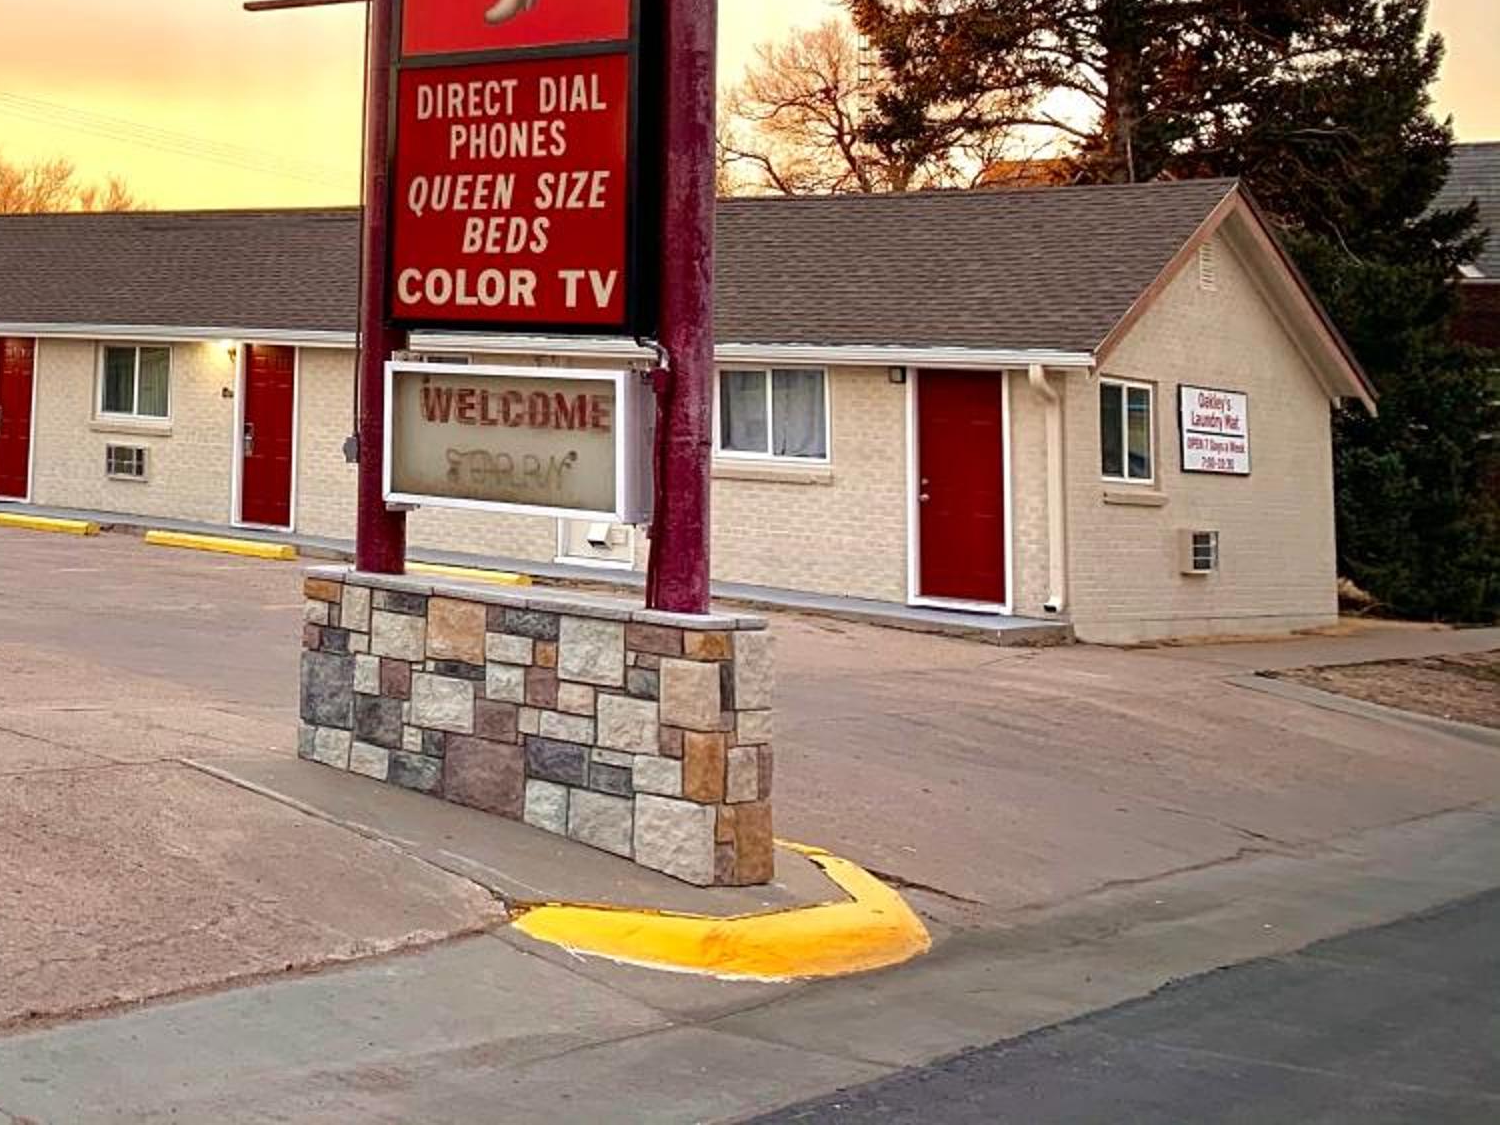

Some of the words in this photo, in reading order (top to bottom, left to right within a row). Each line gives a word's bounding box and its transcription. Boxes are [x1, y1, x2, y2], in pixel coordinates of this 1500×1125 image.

[417, 79, 518, 120] DIRECT
[539, 73, 606, 114] DIAL
[450, 120, 566, 160] PHONES
[407, 174, 515, 217] QUEEN
[534, 170, 610, 209] SIZE
[462, 216, 551, 253] BEDS
[397, 268, 537, 306] COLOR
[558, 269, 617, 308] TV
[420, 385, 612, 433] WELCOME
[1191, 411, 1223, 431] Laundry
